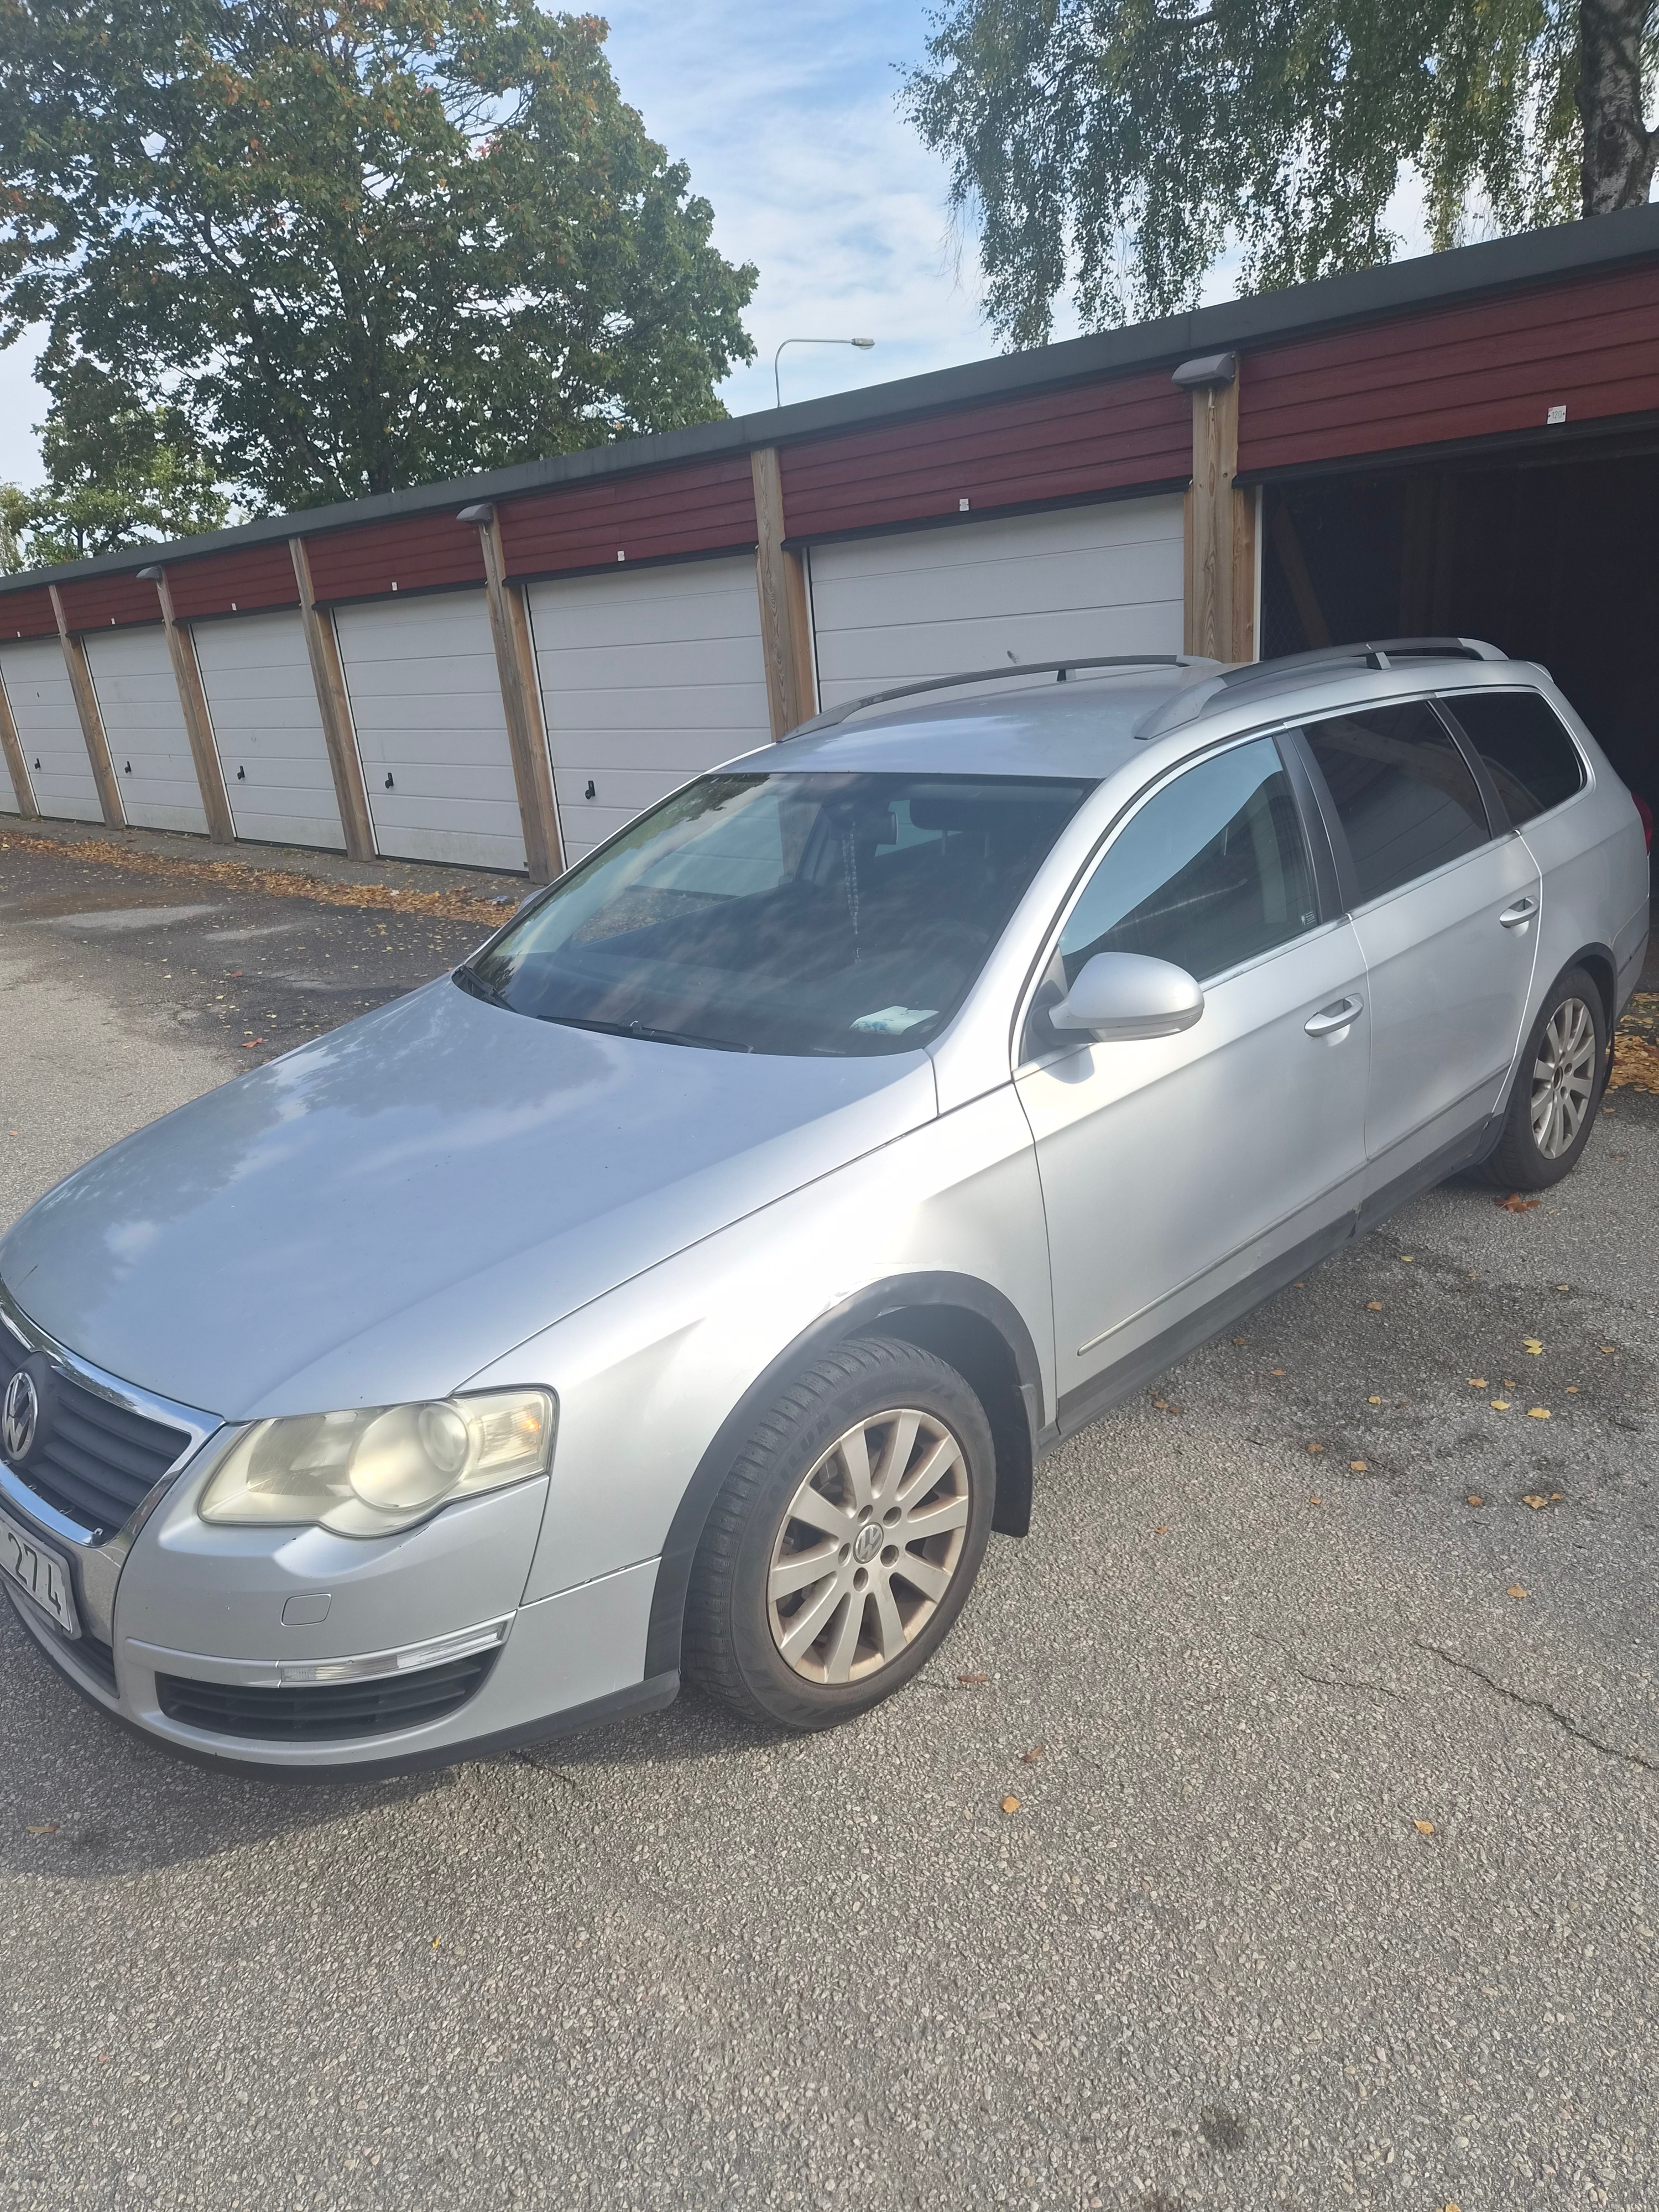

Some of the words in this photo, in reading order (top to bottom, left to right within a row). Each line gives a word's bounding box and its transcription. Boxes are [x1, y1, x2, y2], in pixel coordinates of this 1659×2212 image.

[1552, 410, 1562, 419] 120
[2, 1372, 38, 1460] VW
[8, 1531, 62, 1616] 274
[854, 1523, 883, 1563] VW
